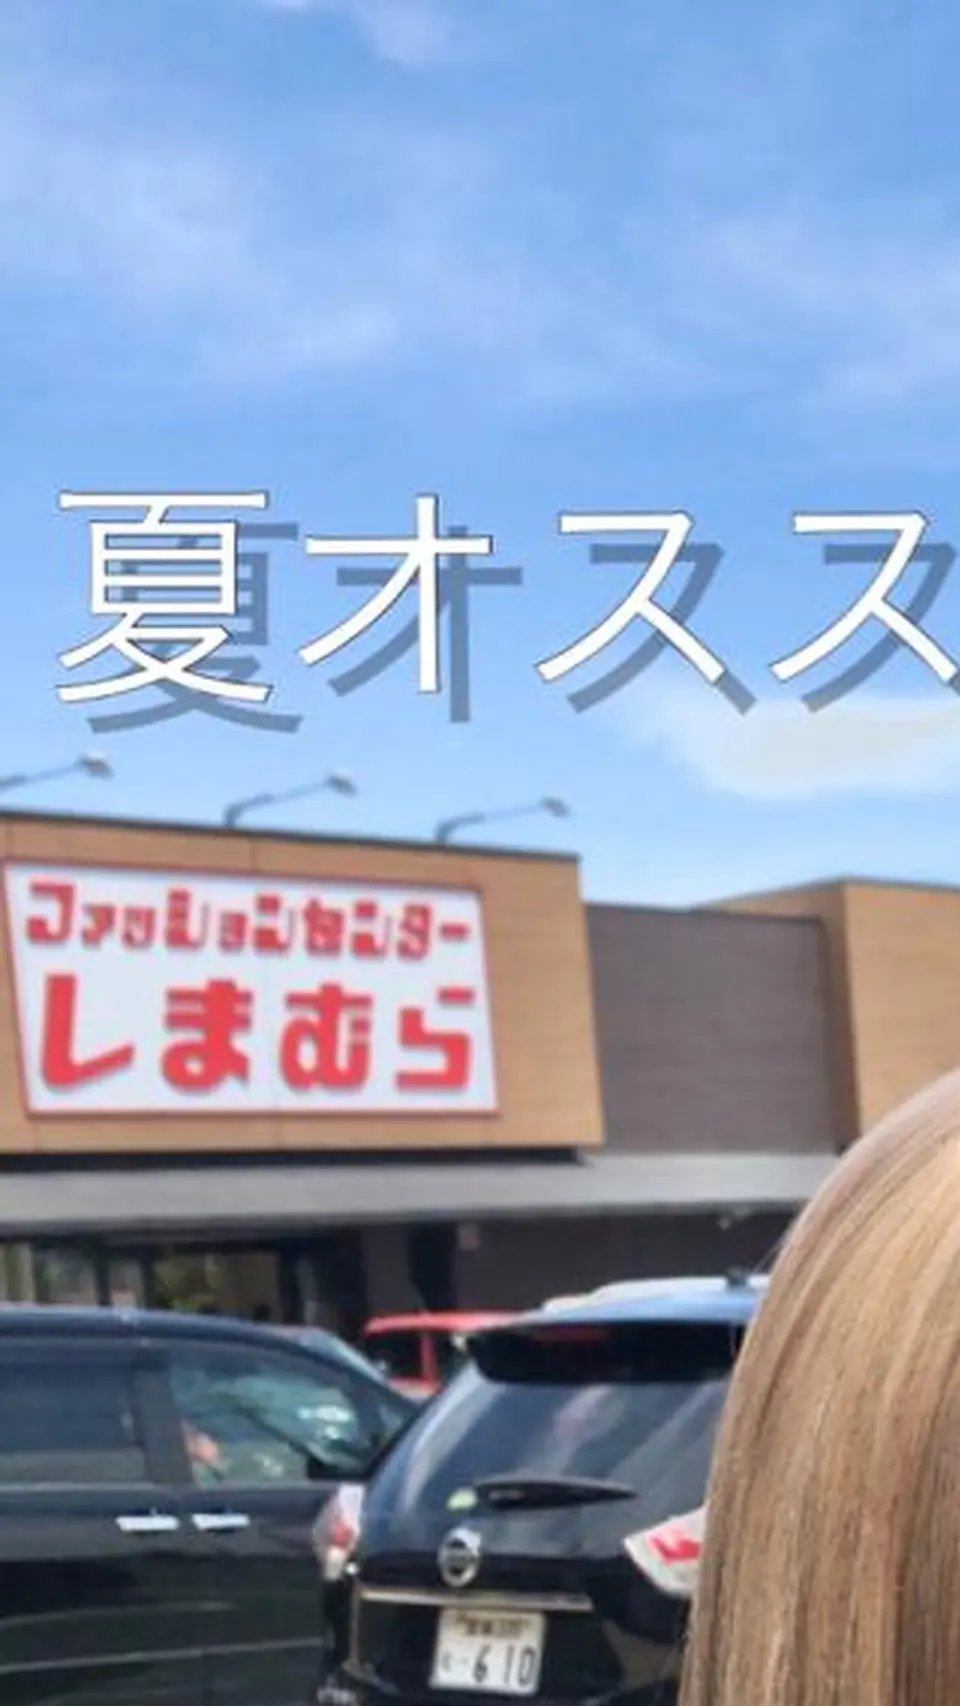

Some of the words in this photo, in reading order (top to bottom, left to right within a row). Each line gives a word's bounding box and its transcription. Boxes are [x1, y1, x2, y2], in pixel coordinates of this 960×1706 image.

[26, 877, 472, 959] ファッションセンター
[40, 973, 475, 1092] しまむら
